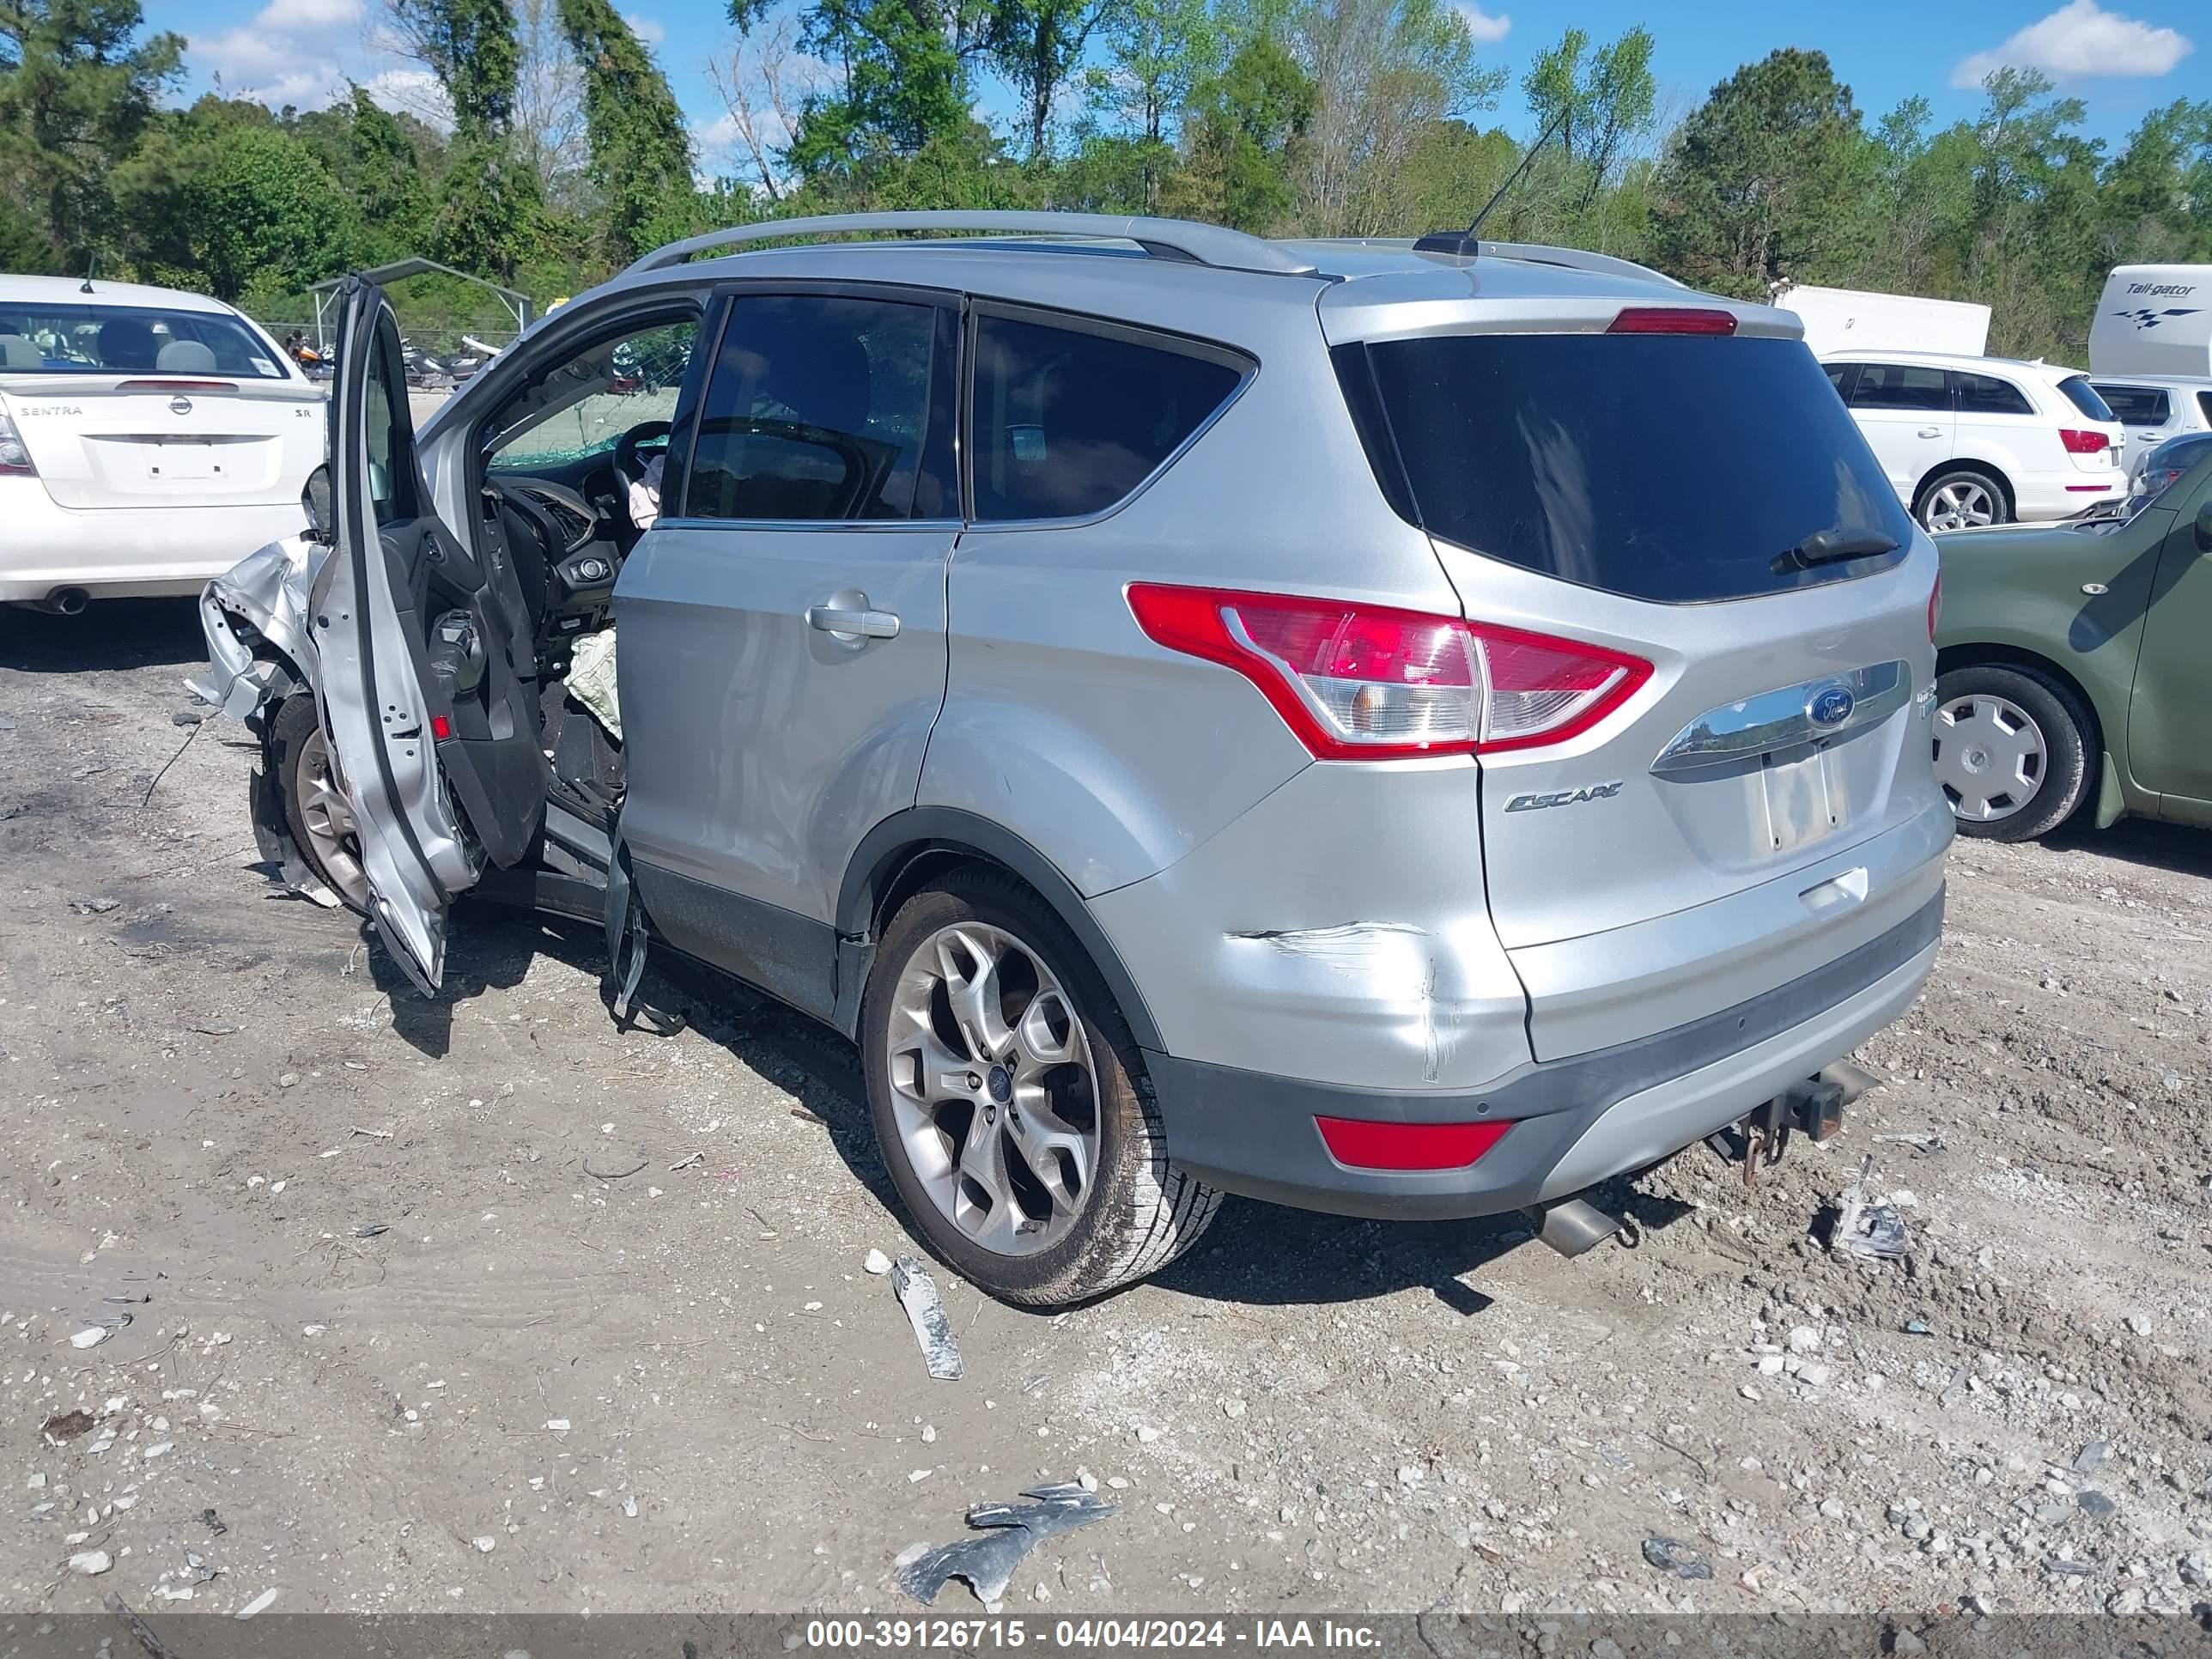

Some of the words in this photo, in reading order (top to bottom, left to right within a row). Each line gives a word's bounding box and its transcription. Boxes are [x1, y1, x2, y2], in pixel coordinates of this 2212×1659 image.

[20, 405, 83, 416] SENTRA
[295, 409, 312, 417] SR
[1823, 694, 1848, 720] Ford
[1504, 781, 1625, 813] ESCAPE
